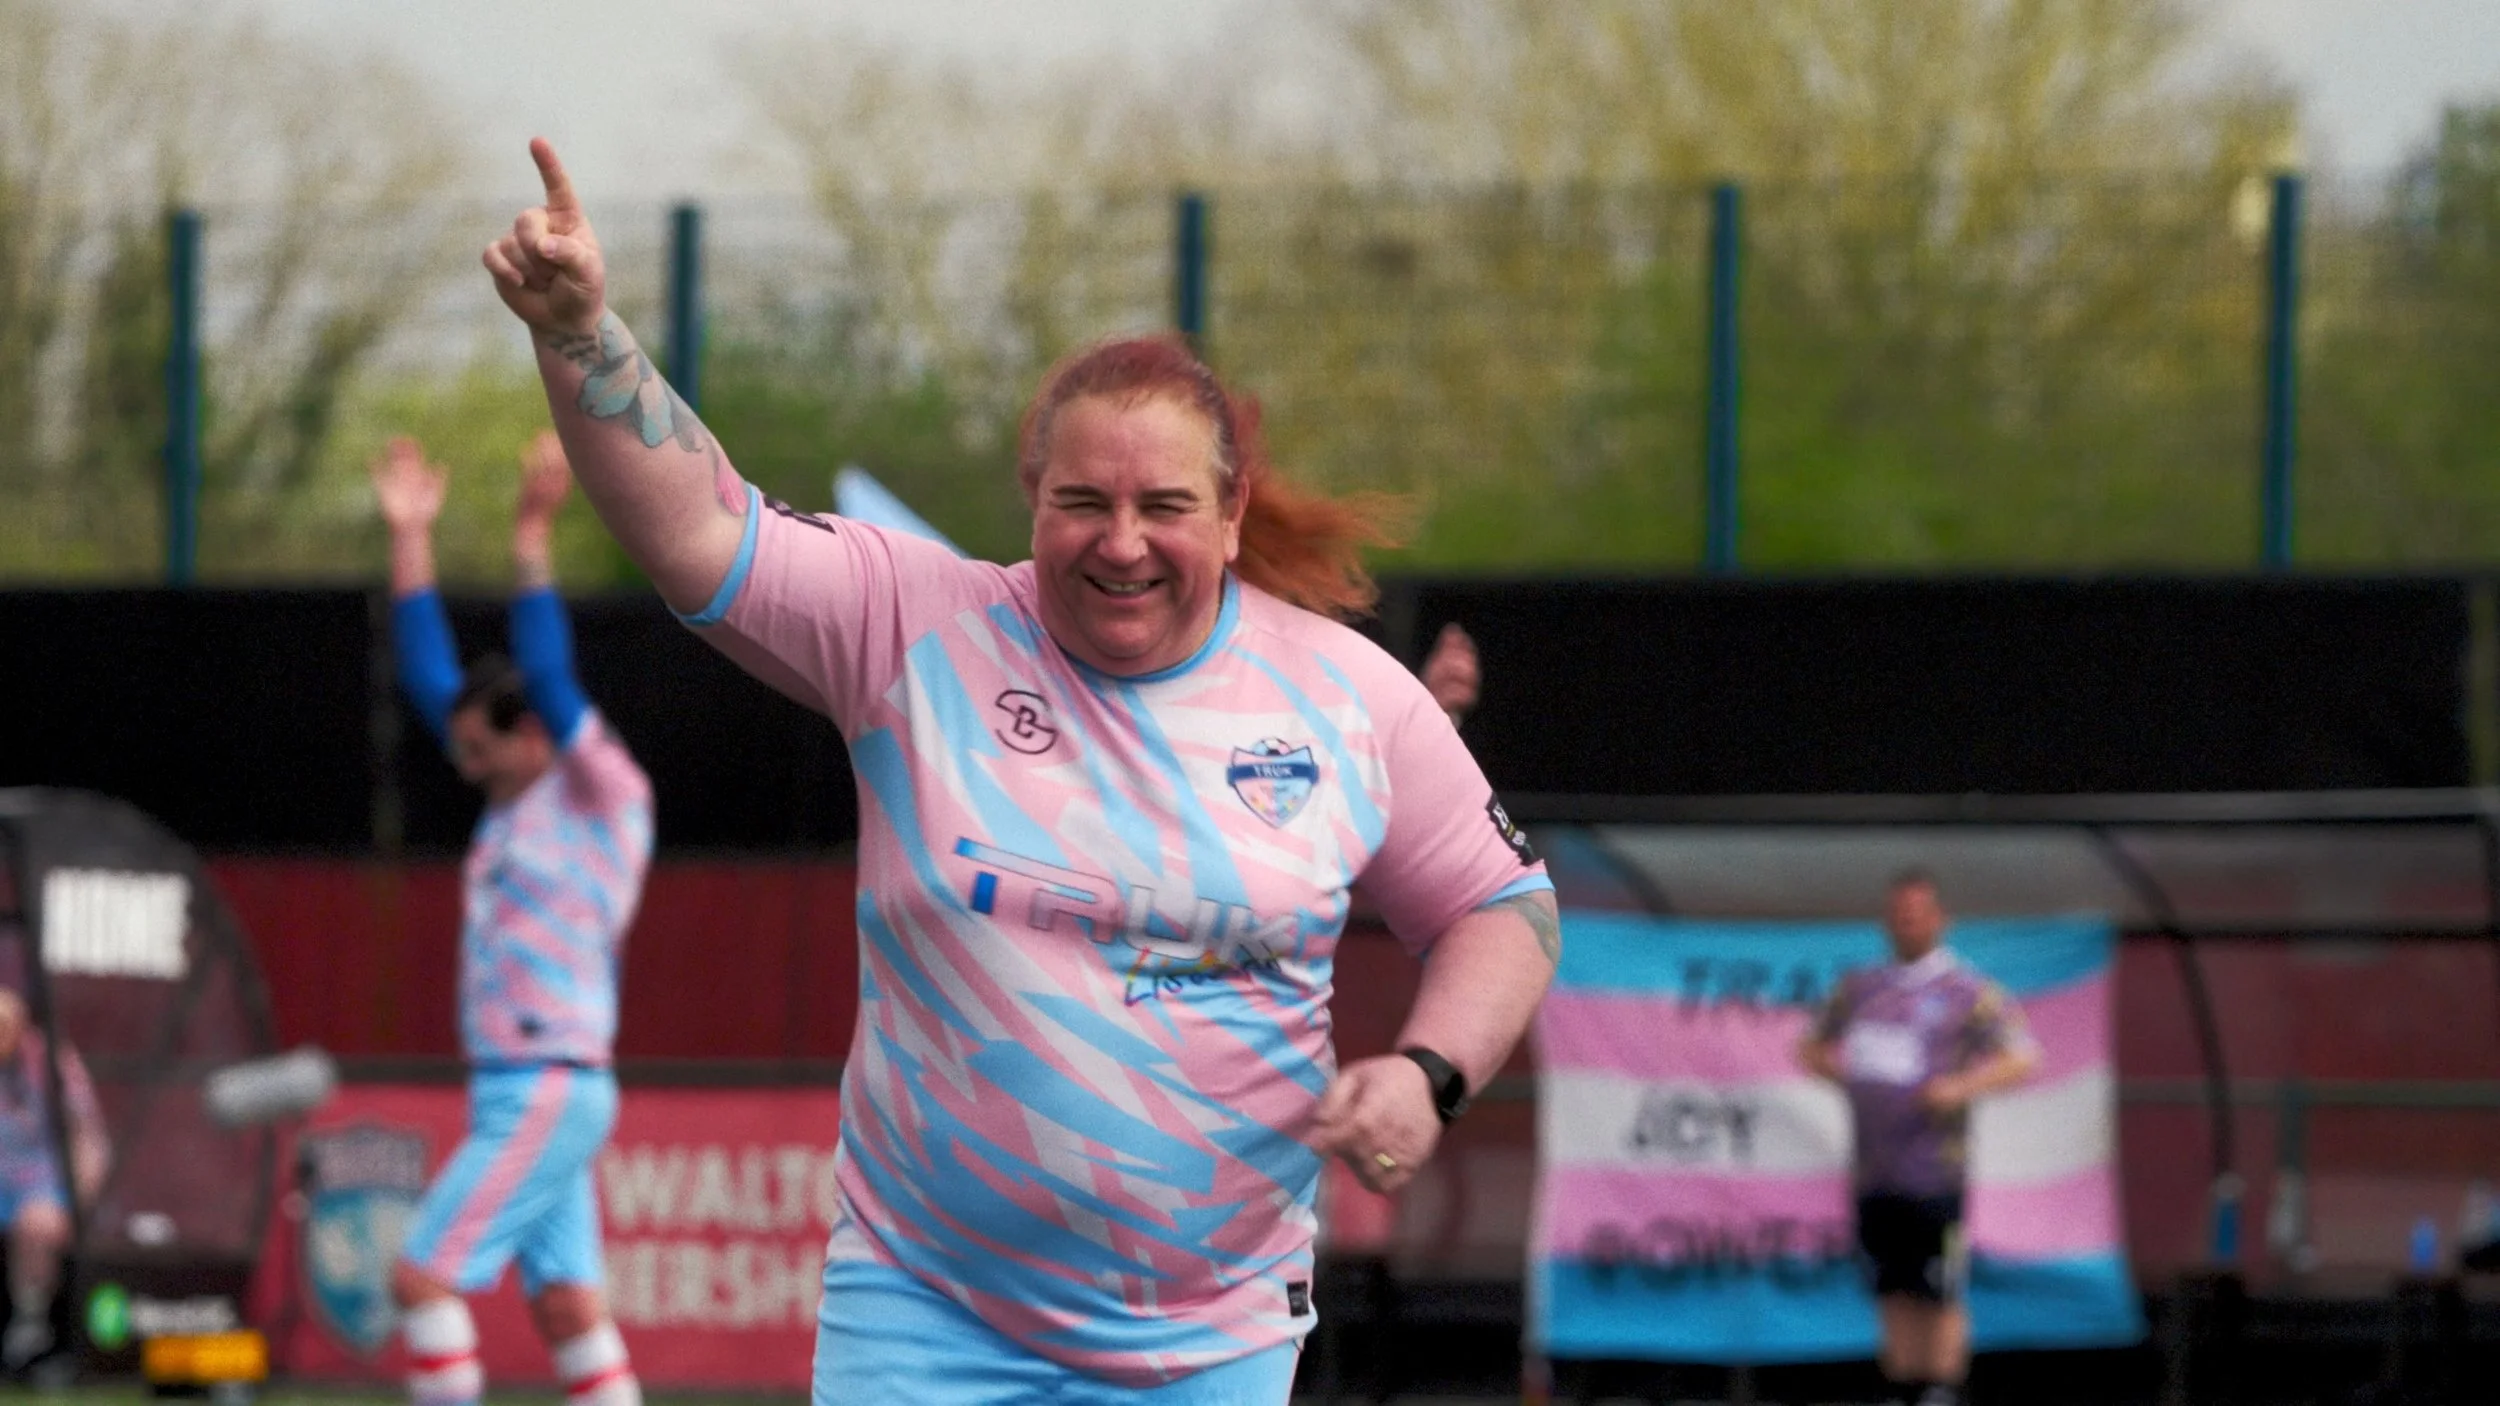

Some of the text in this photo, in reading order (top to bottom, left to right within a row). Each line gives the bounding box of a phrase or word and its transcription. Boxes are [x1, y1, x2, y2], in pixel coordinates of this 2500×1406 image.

[1253, 763, 1294, 778] TRUK
[953, 835, 1298, 961] TRUK
[1678, 957, 1848, 1013] TRA
